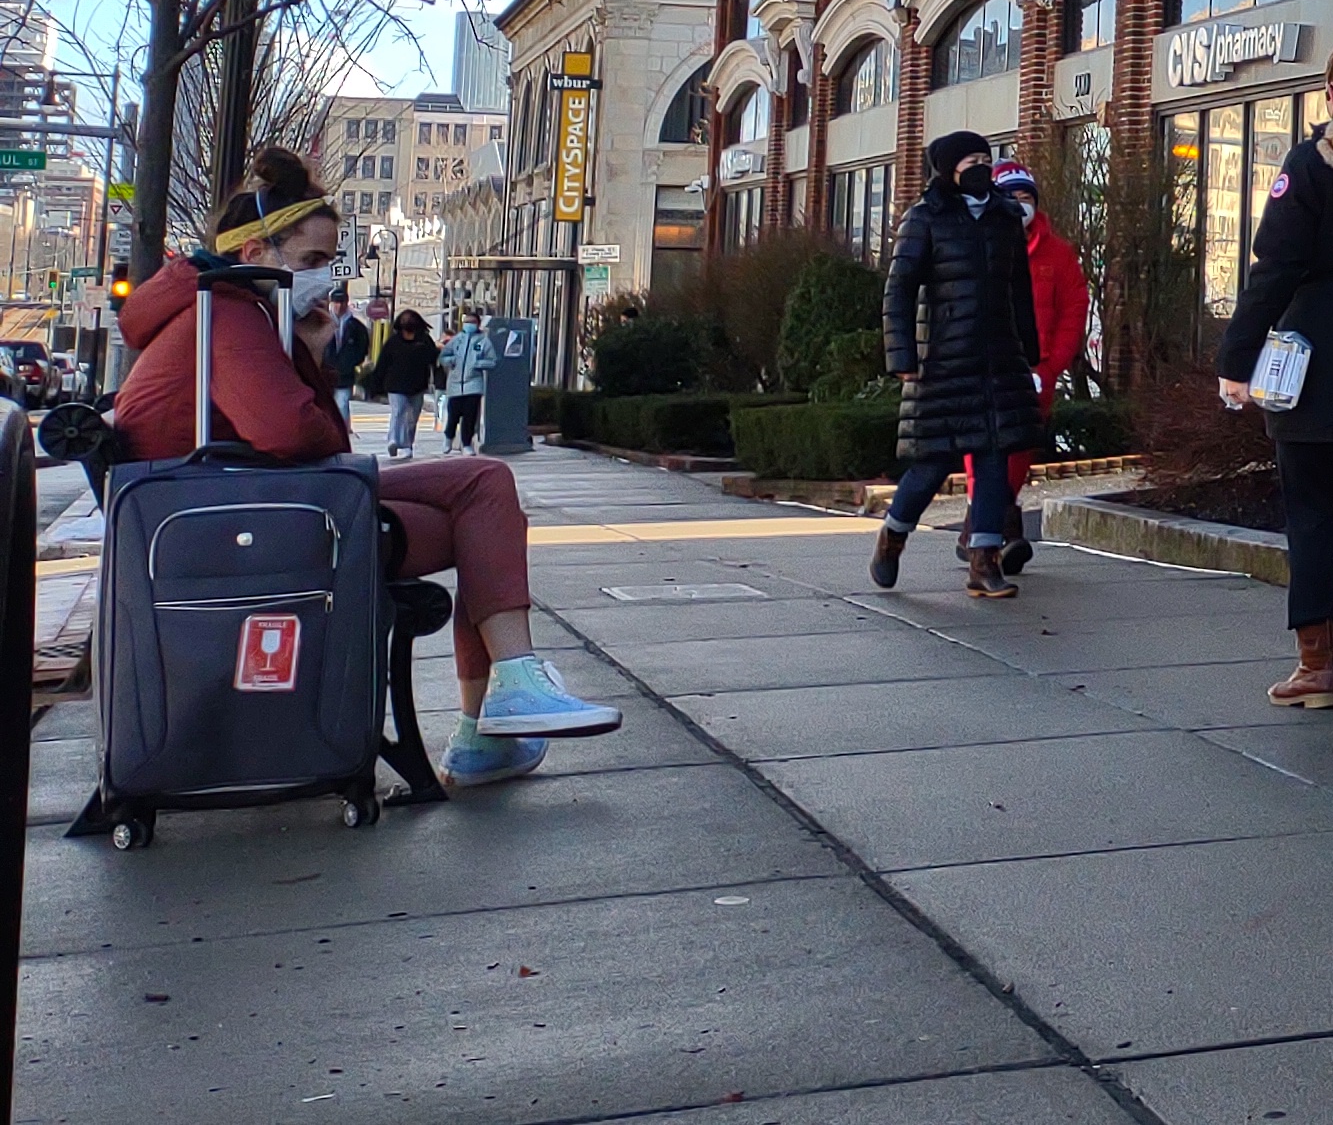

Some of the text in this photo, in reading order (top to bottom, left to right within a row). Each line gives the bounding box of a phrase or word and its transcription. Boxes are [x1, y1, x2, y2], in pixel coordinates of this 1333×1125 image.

[552, 75, 590, 89] wbur
[0, 154, 20, 165] UL
[558, 96, 586, 213] CITYSPACE
